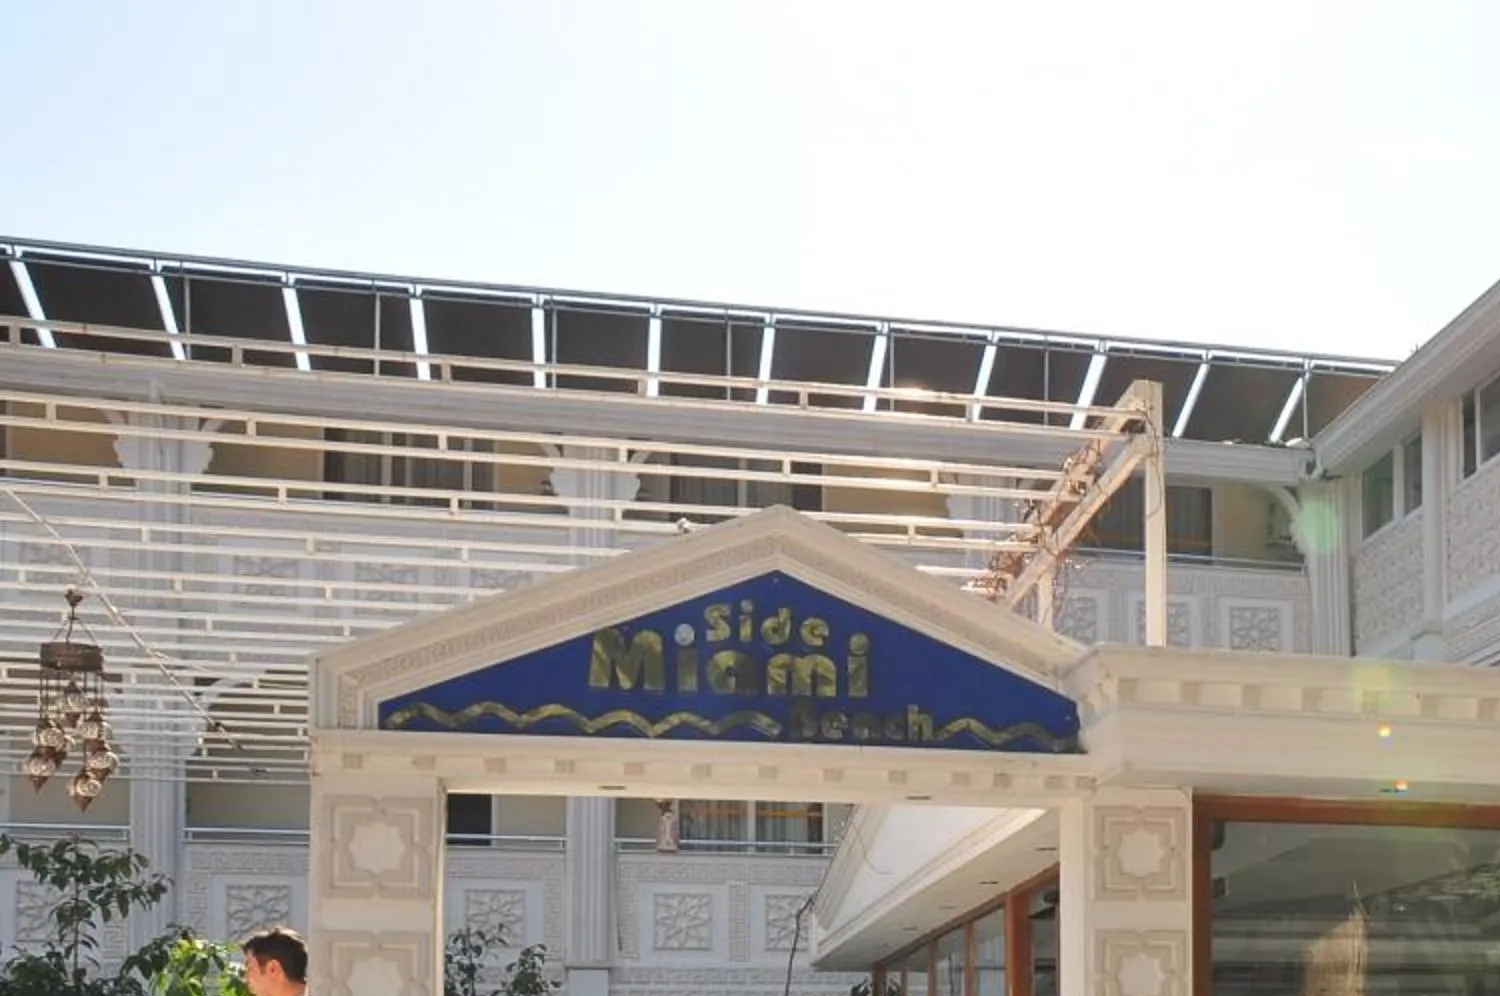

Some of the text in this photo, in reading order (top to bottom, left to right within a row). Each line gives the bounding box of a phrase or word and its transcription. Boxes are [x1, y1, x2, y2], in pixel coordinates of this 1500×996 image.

[704, 599, 830, 647] Side
[588, 627, 869, 698] Miami
[793, 700, 935, 742] Beach
